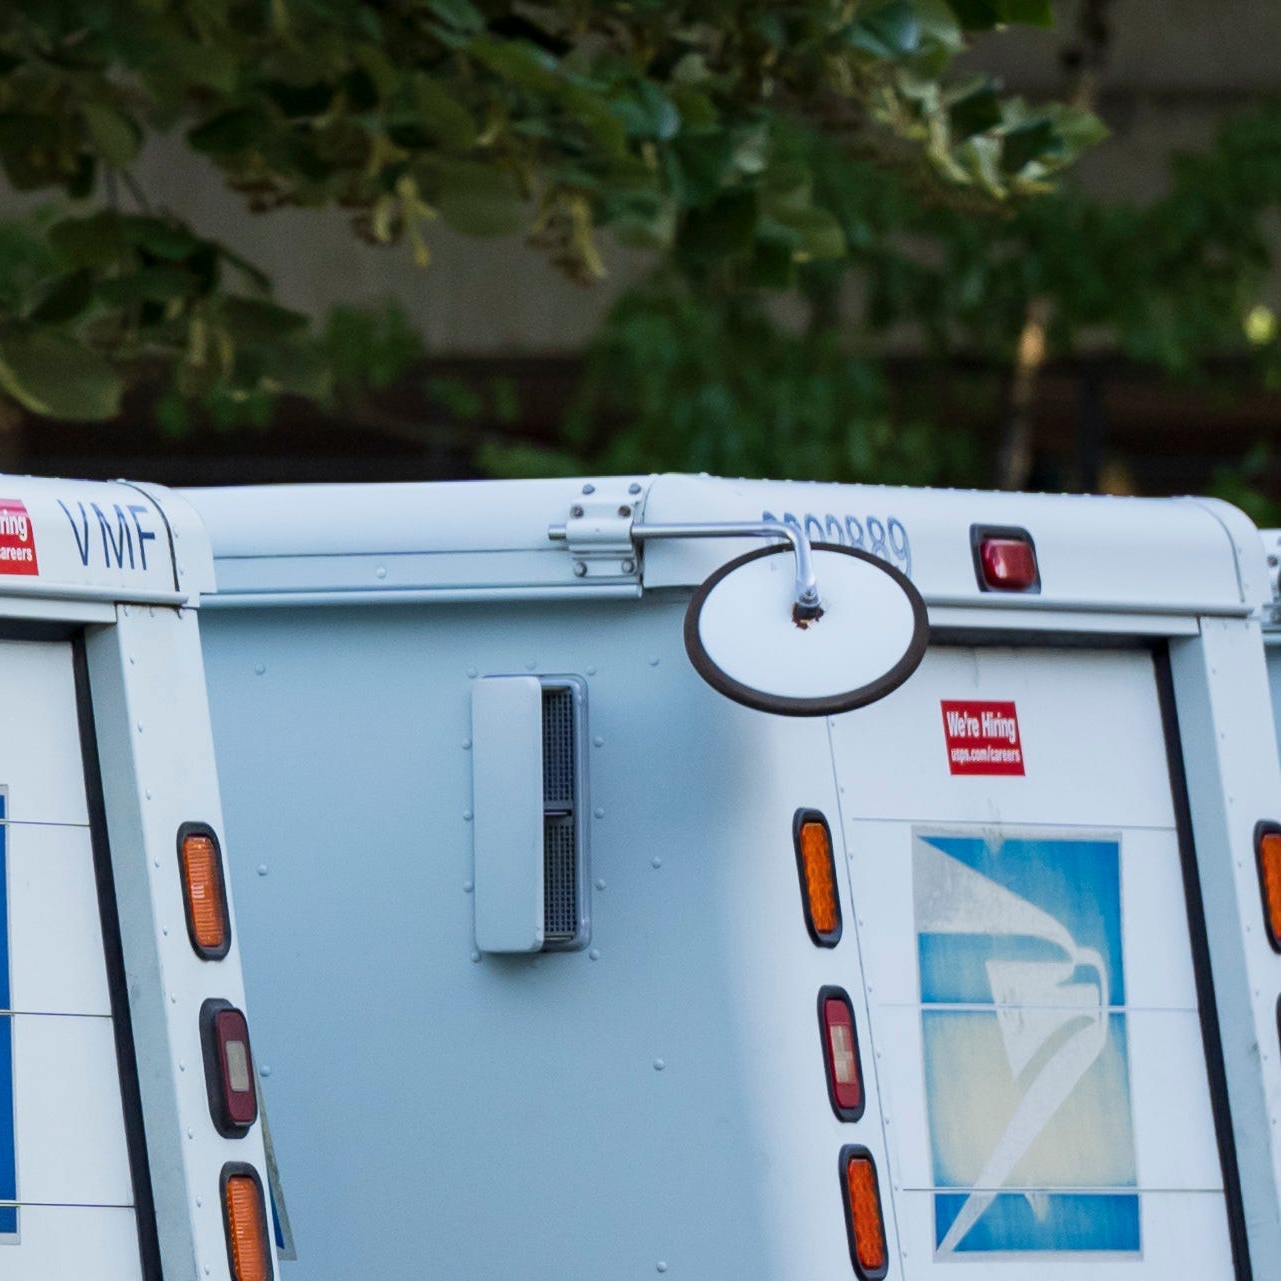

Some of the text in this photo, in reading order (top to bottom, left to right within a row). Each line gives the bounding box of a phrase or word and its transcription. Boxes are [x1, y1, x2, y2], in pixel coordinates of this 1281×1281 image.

[56, 499, 156, 571] VMF
[946, 710, 1016, 744] We're Hiring
